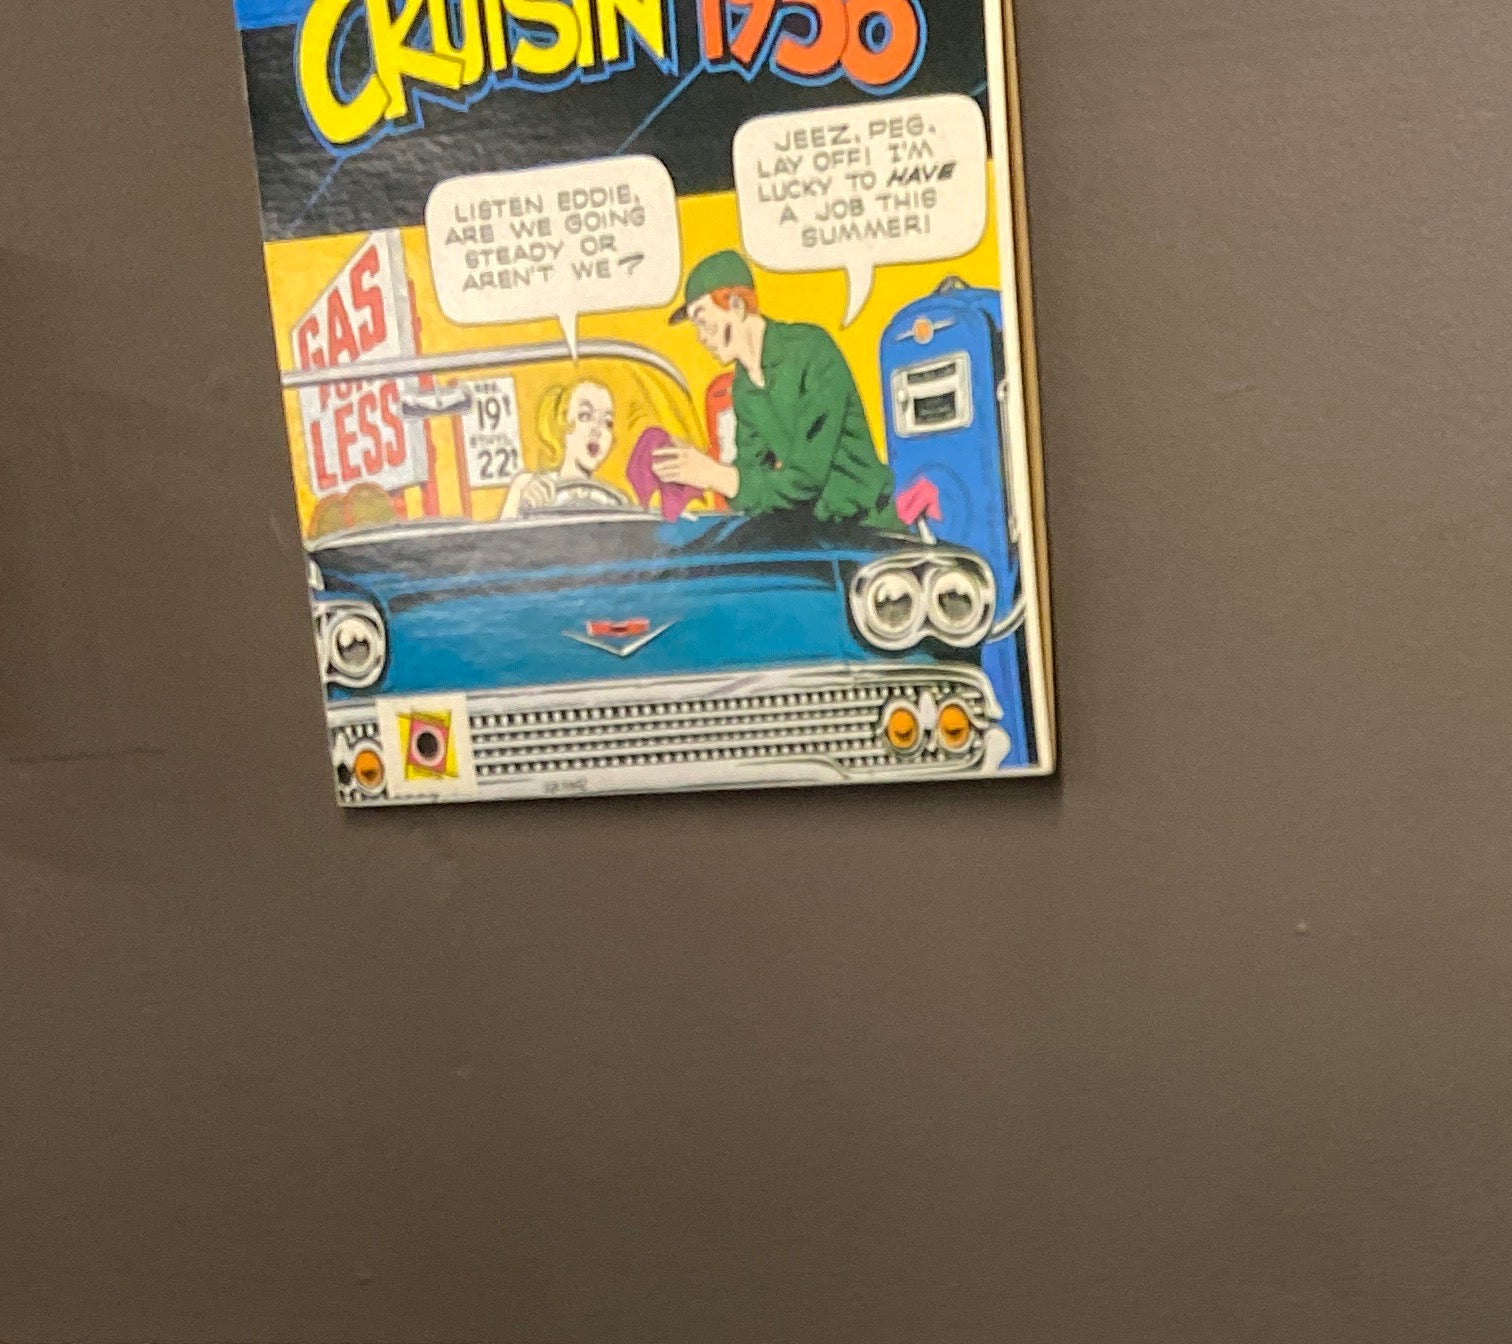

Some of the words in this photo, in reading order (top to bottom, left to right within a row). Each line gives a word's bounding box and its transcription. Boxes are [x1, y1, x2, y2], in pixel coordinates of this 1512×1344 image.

[757, 155, 803, 179] LAY
[813, 147, 872, 172] OFF!
[888, 139, 934, 164] I'M
[757, 178, 832, 202] LUCKY
[845, 171, 878, 191] TO
[886, 161, 958, 187] HAVE
[454, 194, 544, 223] LISTEN
[556, 183, 641, 212] EDDIE,
[779, 205, 799, 225] A
[815, 199, 865, 222] JOB
[875, 187, 938, 211] THIS
[444, 224, 495, 246] ARE
[509, 217, 552, 240] WE
[564, 205, 646, 234] GOING
[801, 214, 931, 248] SUMMER!
[464, 238, 564, 269] STEADY
[580, 234, 618, 257] OR
[462, 265, 555, 292] AREN'T
[297, 244, 387, 372] GAS
[310, 378, 408, 491] LESS
